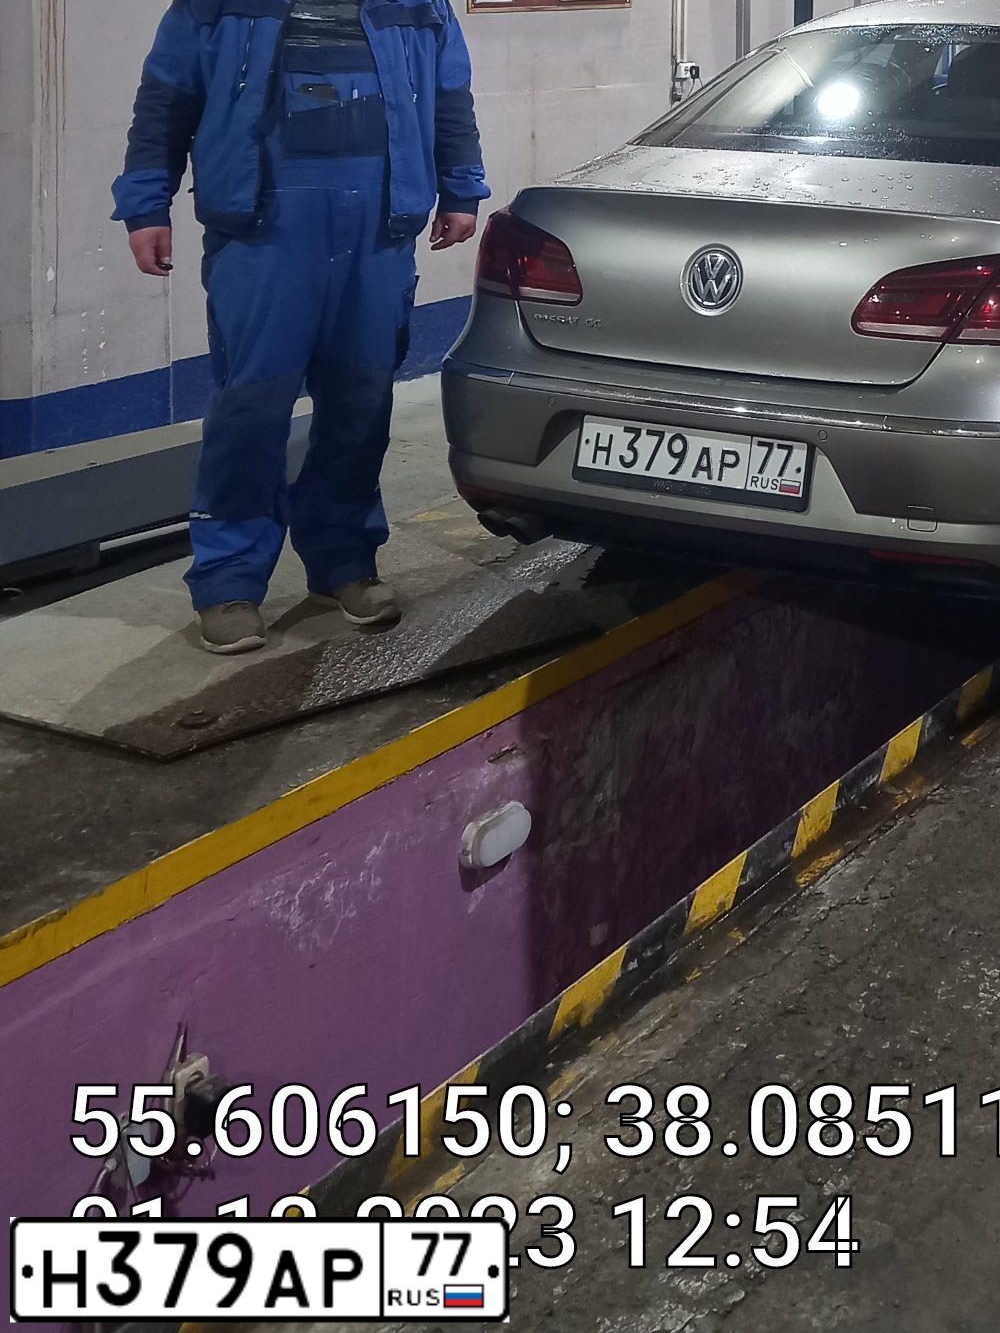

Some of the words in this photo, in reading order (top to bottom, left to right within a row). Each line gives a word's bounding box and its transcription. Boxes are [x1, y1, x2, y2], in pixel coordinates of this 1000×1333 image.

[592, 426, 740, 481] Н379АР
[757, 441, 794, 477] 77
[750, 476, 779, 491] RUS
